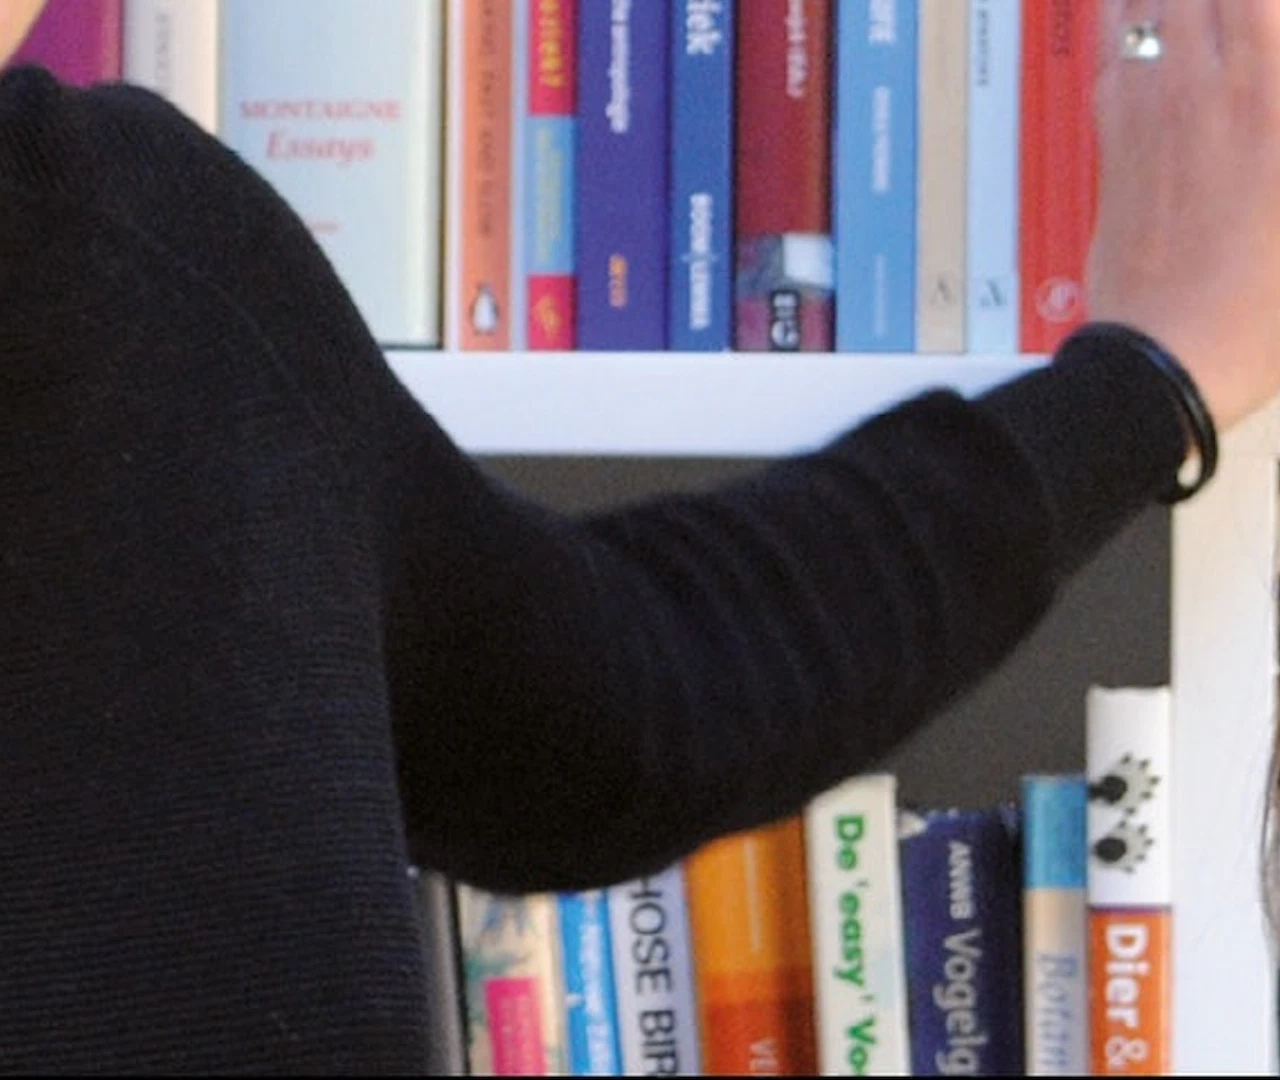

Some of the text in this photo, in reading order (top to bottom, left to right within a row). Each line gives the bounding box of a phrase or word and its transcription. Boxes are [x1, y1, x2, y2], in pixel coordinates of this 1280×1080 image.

[239, 99, 402, 120] MONTAIGNE
[267, 130, 377, 168] Essays
[835, 814, 866, 871] De
[931, 841, 988, 1077] ANWB Vogelg
[1104, 923, 1151, 1070] Dier &
[846, 1016, 879, 1077] Vo
